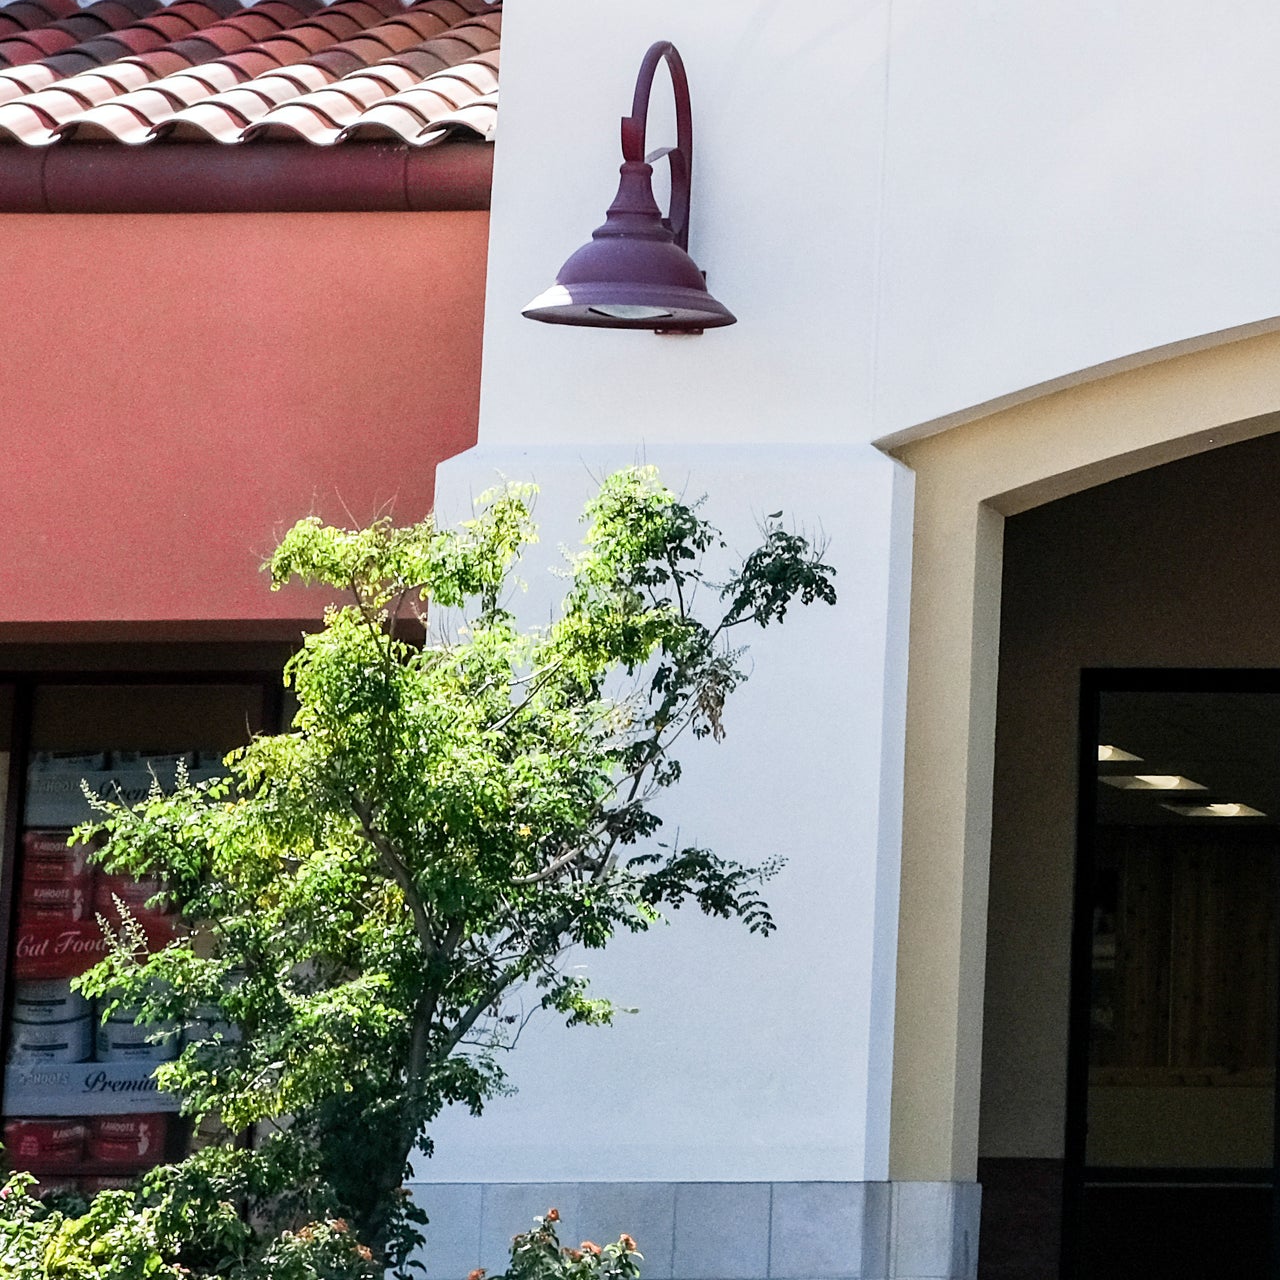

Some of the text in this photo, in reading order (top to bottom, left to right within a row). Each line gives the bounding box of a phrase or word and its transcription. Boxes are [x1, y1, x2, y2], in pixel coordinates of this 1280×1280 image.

[34, 841, 70, 852] KAHOOT
[16, 935, 49, 957] Cat
[101, 1122, 135, 1132] KAHOOTS
